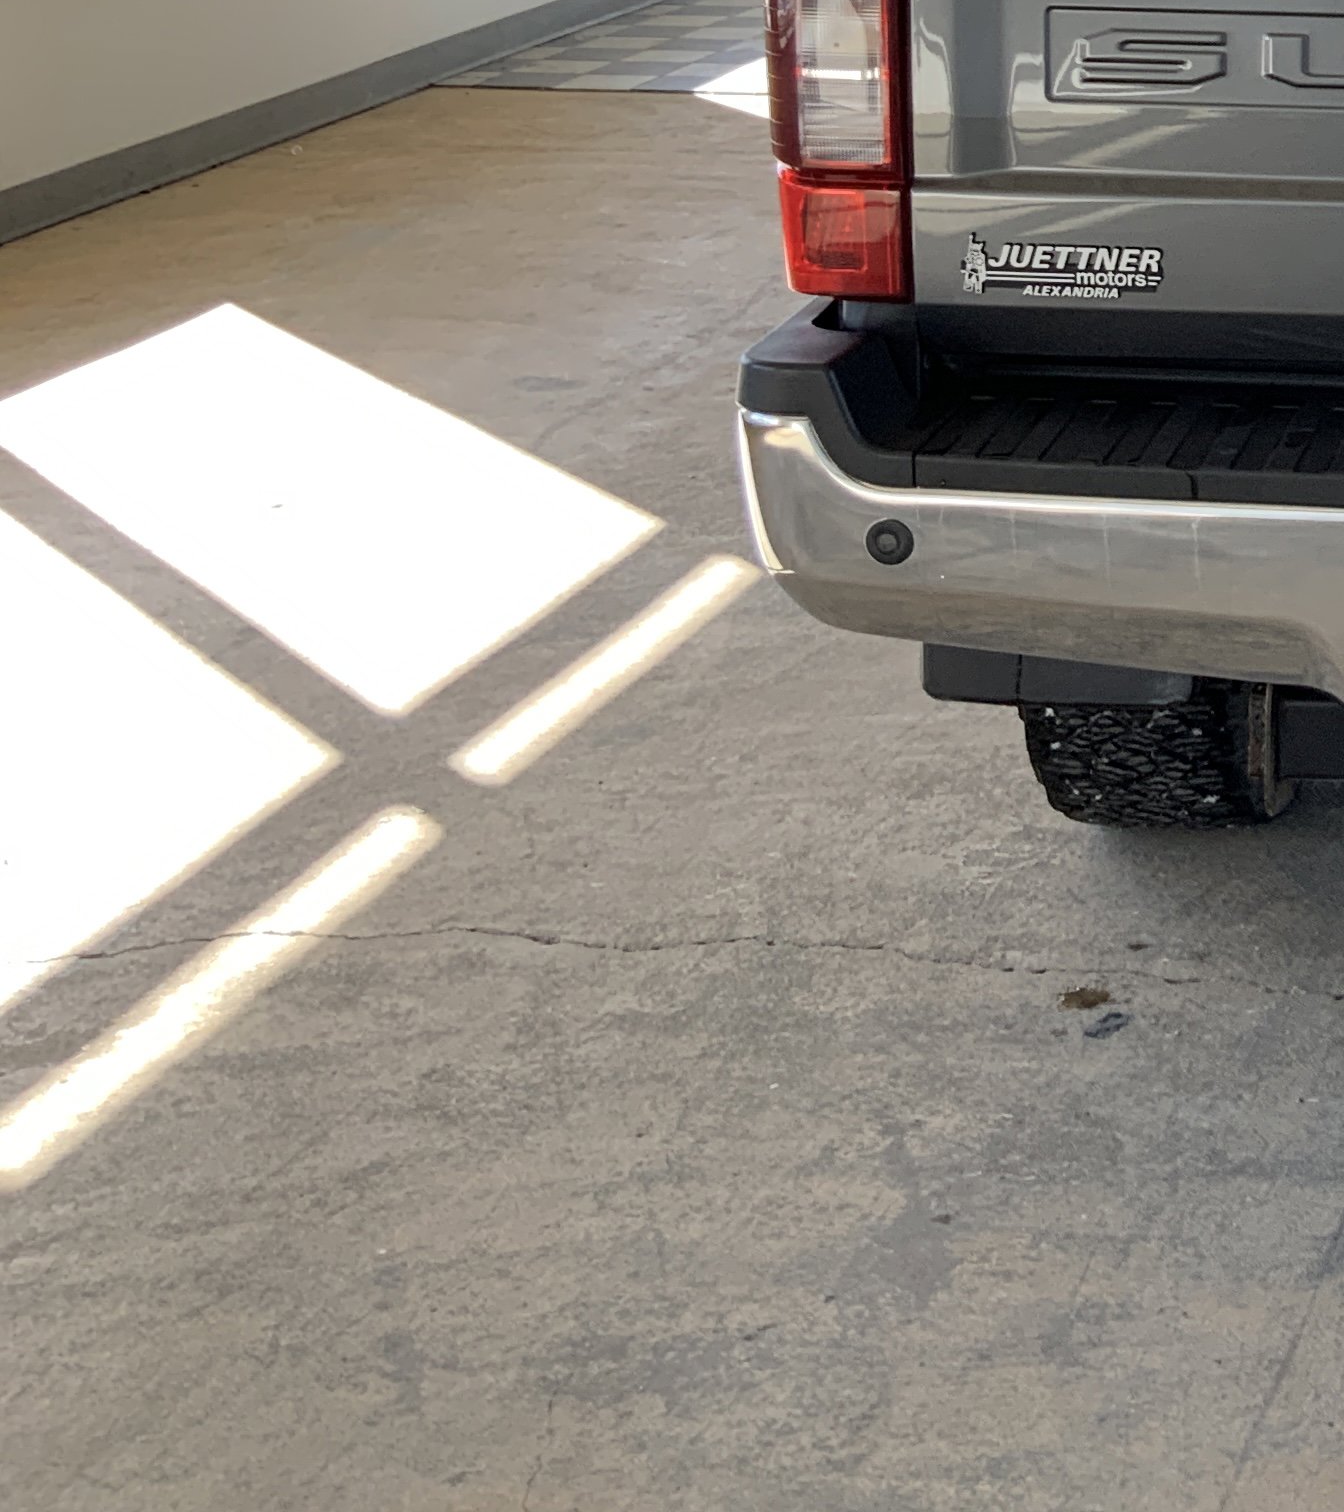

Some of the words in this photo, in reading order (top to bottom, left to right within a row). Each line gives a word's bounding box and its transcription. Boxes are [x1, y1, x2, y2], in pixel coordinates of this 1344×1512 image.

[988, 243, 1161, 272] JUETTNER
[1076, 272, 1147, 287] motors
[1023, 285, 1119, 299] ALEXANDRIA
